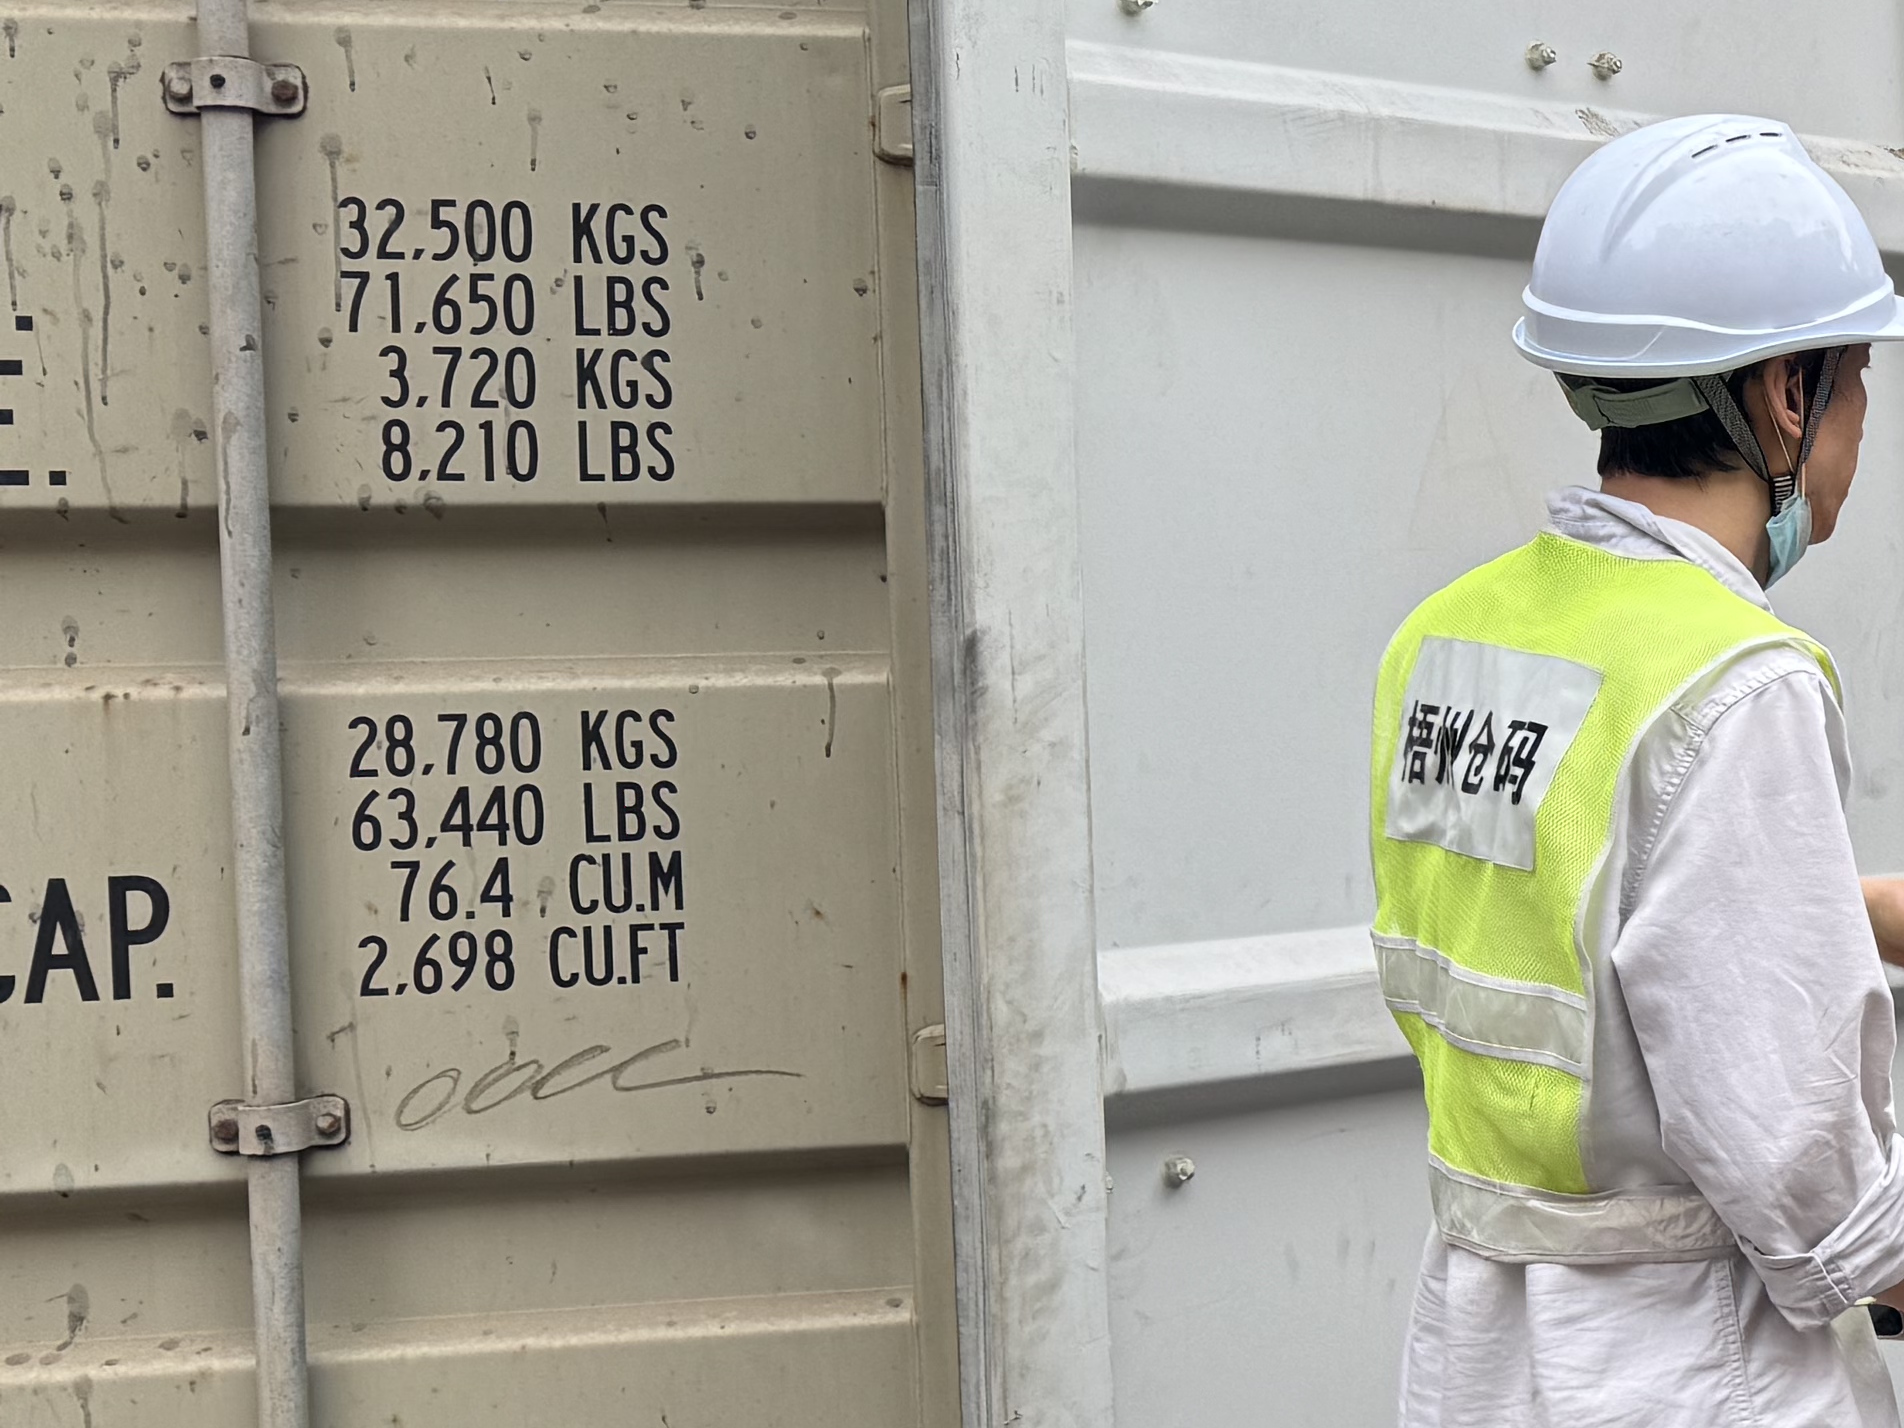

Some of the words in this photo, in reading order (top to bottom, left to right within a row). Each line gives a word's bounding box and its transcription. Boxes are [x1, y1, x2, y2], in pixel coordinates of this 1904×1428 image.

[338, 196, 534, 264] 32,500
[572, 200, 671, 266] KGS
[341, 270, 536, 337] 71,650
[573, 274, 673, 338] LBS
[378, 344, 538, 411] 3,720
[575, 347, 675, 412] KGS
[381, 420, 540, 484] 8,210
[577, 420, 676, 483] LBS
[347, 710, 542, 780] 28,780
[579, 707, 678, 772] KGS
[350, 782, 544, 852] 63,440
[583, 780, 682, 845] LBS
[389, 856, 514, 924] 76.4
[568, 851, 685, 916] CU.M
[0, 873, 175, 1006] AP.
[358, 927, 516, 998] 2,698
[549, 922, 686, 989] CU.FT
